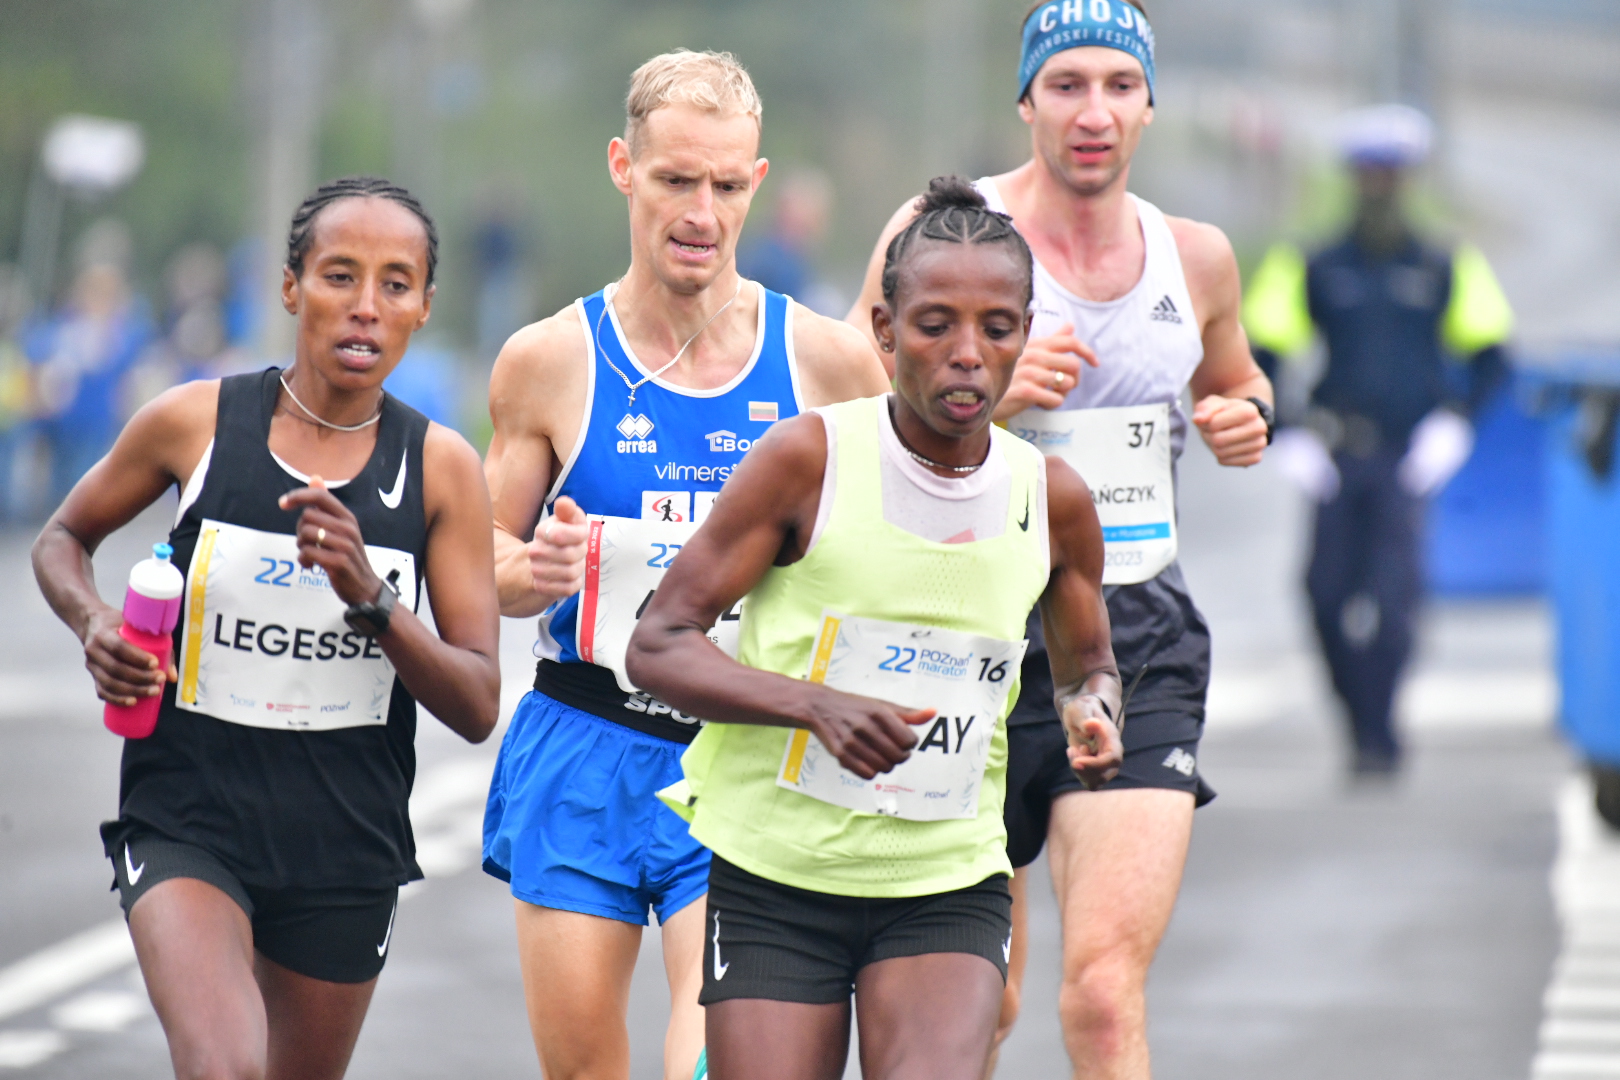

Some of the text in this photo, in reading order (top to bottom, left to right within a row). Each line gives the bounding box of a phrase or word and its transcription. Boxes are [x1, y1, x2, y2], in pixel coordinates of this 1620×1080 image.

[1128, 421, 1155, 448] 37
[254, 557, 295, 587] 22
[214, 614, 383, 661] LEGESSE
[878, 645, 916, 673] 22
[918, 661, 967, 677] maraton
[978, 657, 1008, 683] 16
[918, 715, 976, 754] AY
